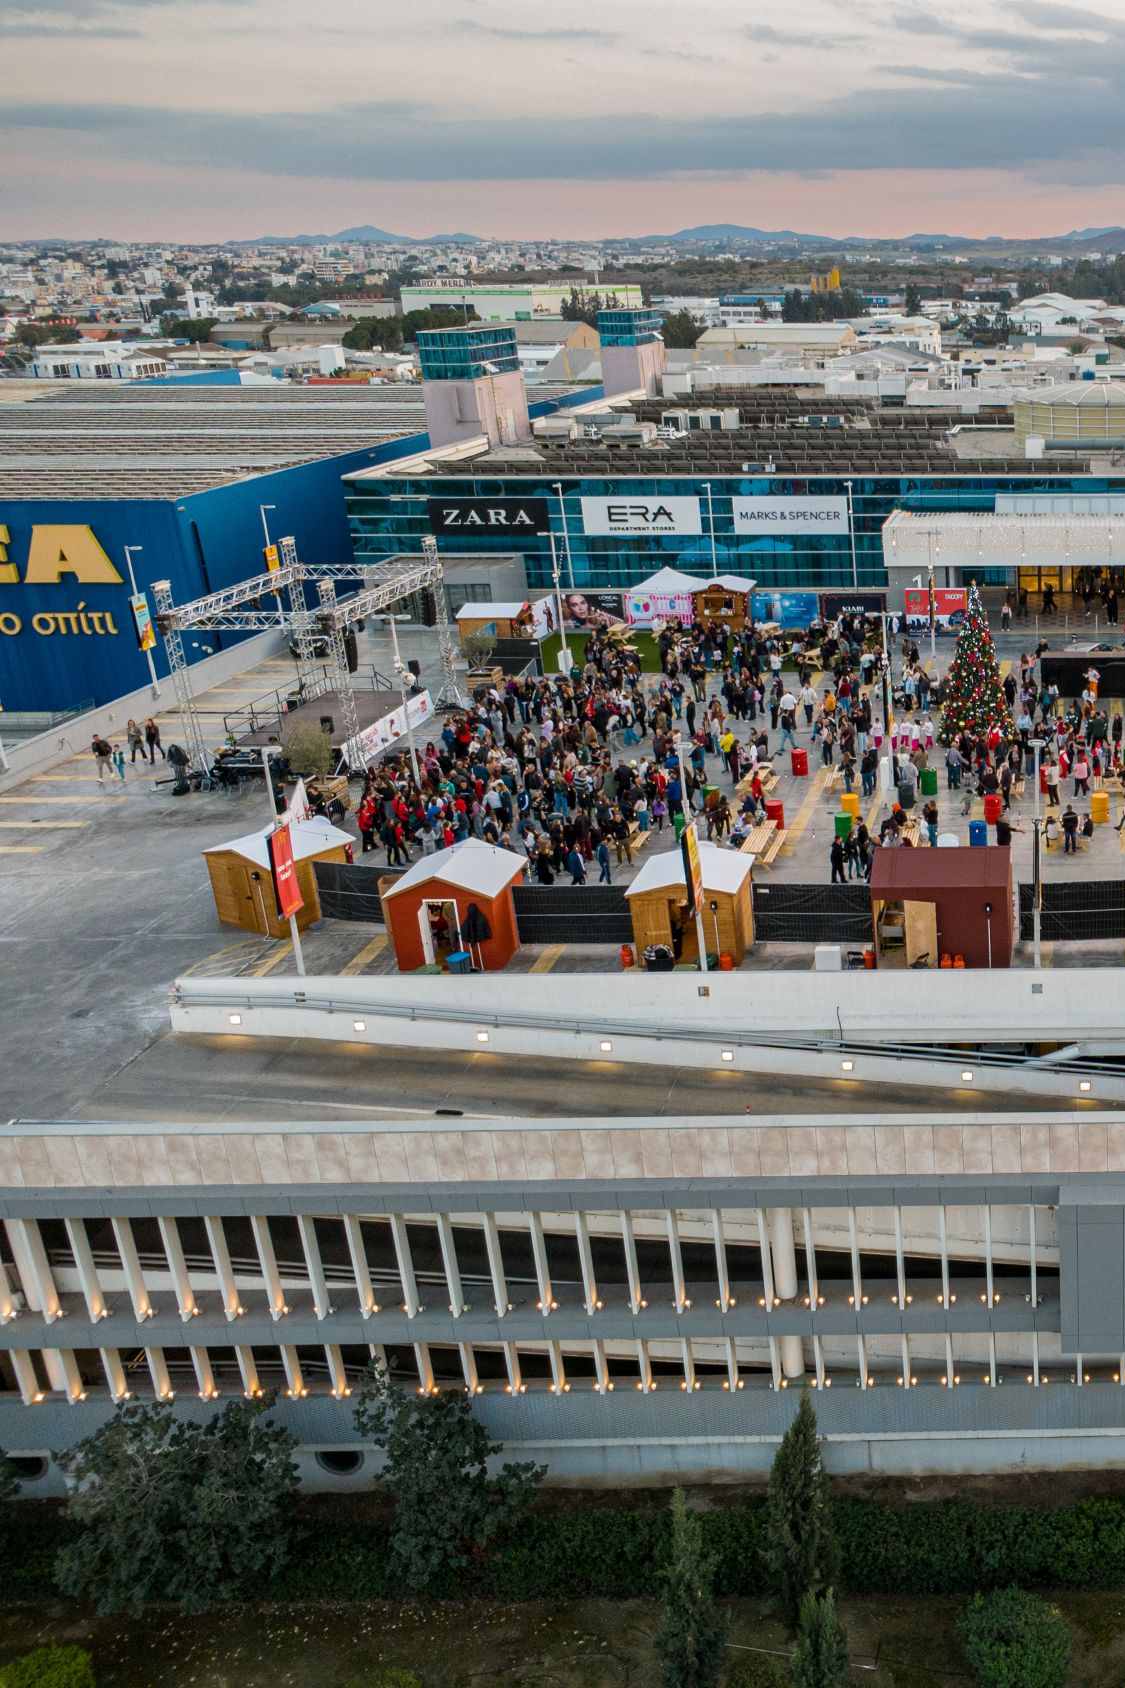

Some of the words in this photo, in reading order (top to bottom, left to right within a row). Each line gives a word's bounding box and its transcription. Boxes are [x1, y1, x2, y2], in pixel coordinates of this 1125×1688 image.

[443, 509, 535, 526] ZARA
[607, 505, 674, 523] ERA
[740, 511, 777, 521] MARKS
[779, 511, 787, 521] &
[789, 511, 841, 521] SPENCER
[32, 601, 119, 635] σπίτι
